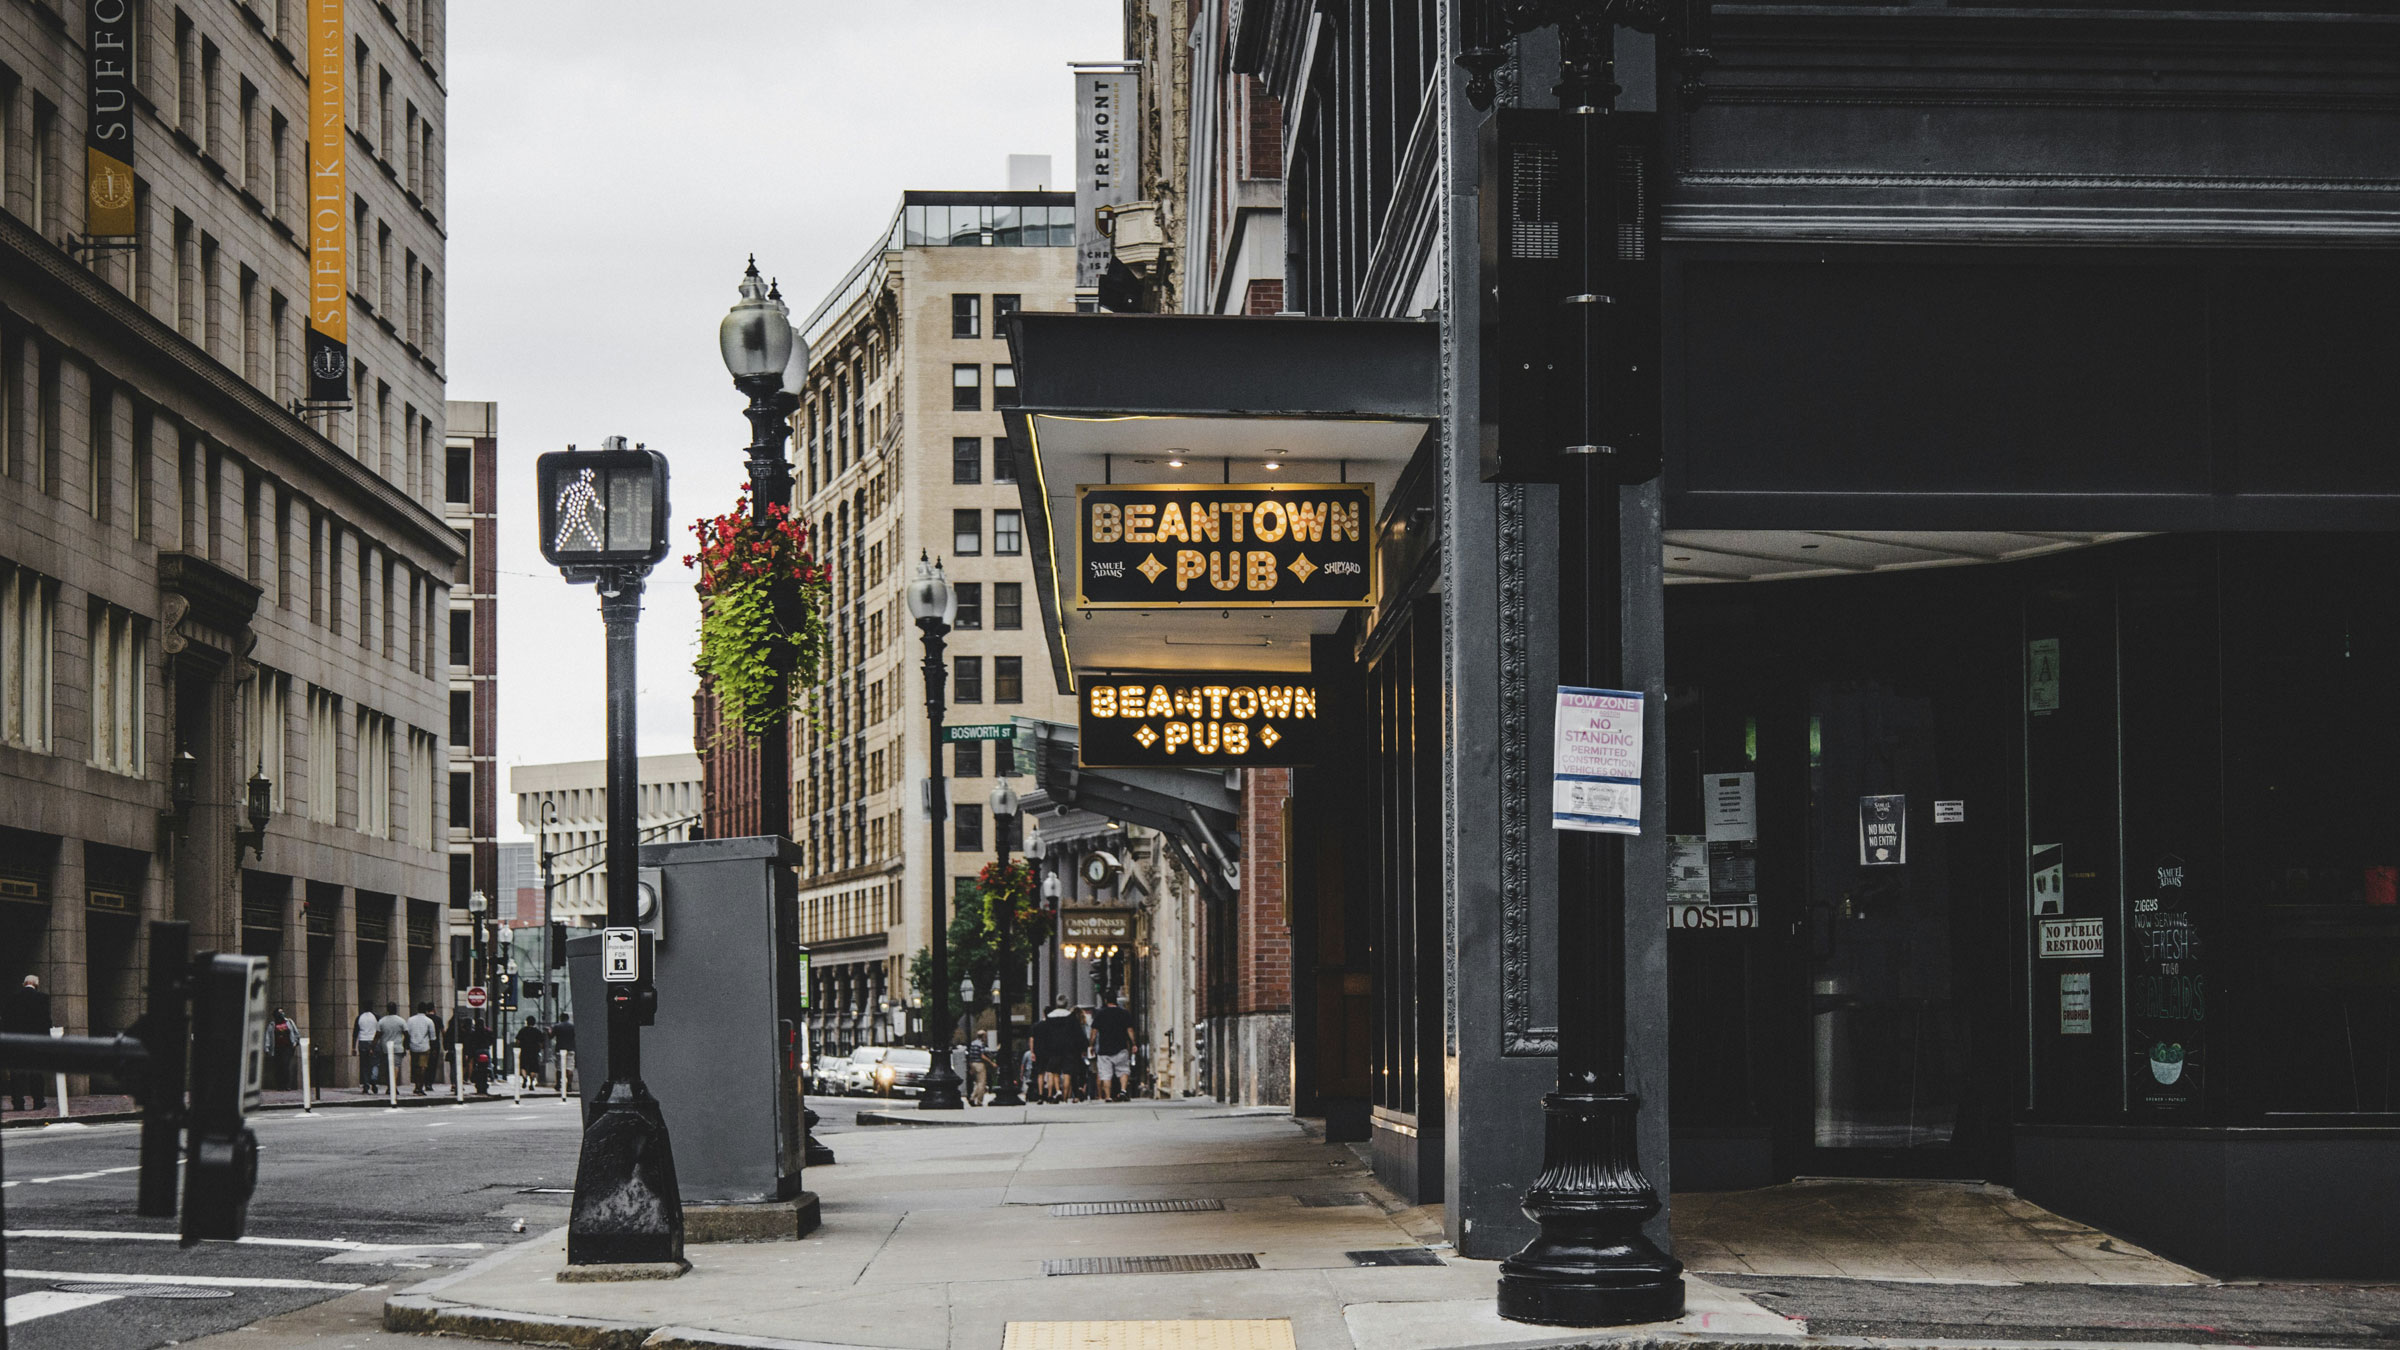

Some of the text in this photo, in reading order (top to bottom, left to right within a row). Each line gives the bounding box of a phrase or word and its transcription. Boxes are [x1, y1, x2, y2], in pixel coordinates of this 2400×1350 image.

[1095, 81, 1110, 191] TREMONT
[315, 159, 341, 324] SUFFOLK
[1090, 262, 1101, 270] IS
[1091, 500, 1360, 543] BEANTOWN
[1090, 561, 1126, 571] SAMUEL
[1176, 549, 1278, 591] PUB
[1324, 561, 1361, 576] SHIPYARD
[1093, 569, 1123, 578] ADAMS
[1090, 684, 1316, 719] BEANTOWN
[1568, 695, 1635, 710] TOW ZONE
[1590, 718, 1611, 730] NO
[951, 726, 1011, 739] BOSWORTH ST
[1164, 721, 1250, 755] PUB
[1565, 730, 1633, 747] STANDING
[1571, 745, 1627, 757] PERMITTED
[1562, 754, 1636, 768] CONSTRUCTION
[1563, 765, 1634, 777] VEHICLES ONLY
[1868, 824, 1877, 835] NO
[1869, 835, 1897, 847] NO ENTRY
[2157, 866, 2184, 879] SAMUEL
[2159, 877, 2182, 888] ADAMS
[2134, 899, 2159, 912] ZIGGYS
[2134, 914, 2152, 929] NOW
[1082, 927, 1110, 936] HOUSE
[2046, 925, 2103, 938] NO PUBLIC
[2046, 939, 2103, 952] RESTROOM
[2152, 929, 2189, 960] FRESH
[2134, 974, 2207, 1022] SALADS
[2063, 1009, 2089, 1021] GRUBHUB
